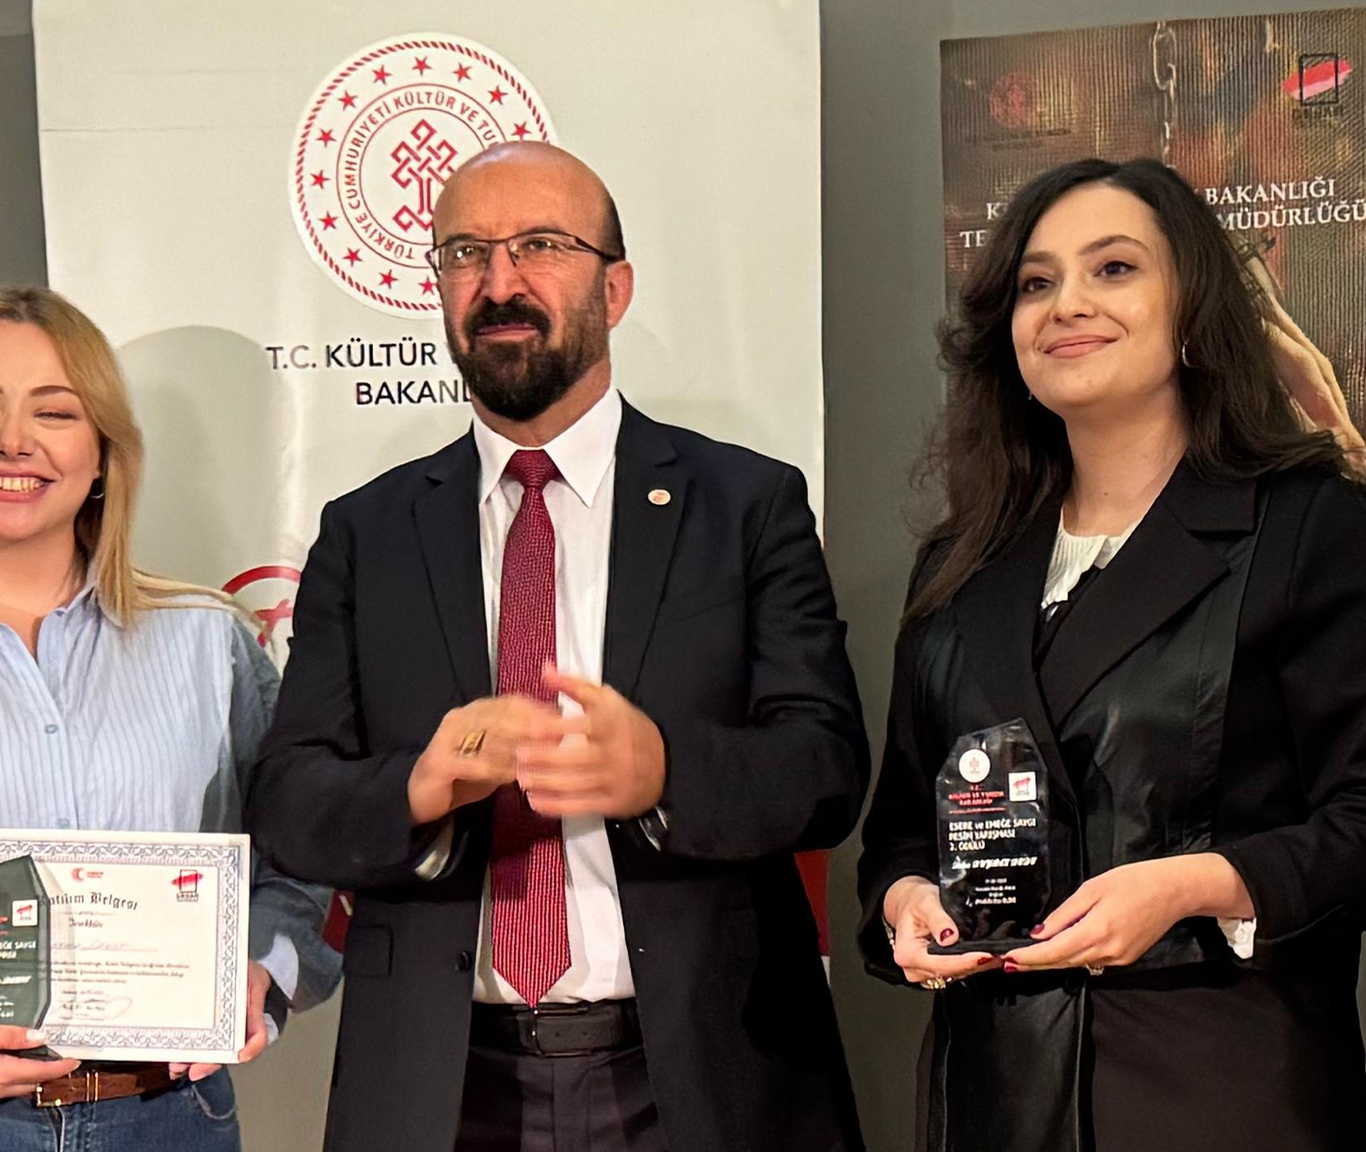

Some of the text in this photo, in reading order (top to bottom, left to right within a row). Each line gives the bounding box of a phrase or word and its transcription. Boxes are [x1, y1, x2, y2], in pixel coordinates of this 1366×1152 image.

[394, 91, 456, 110] KÜLTÜR
[460, 103, 479, 122] VE
[344, 101, 392, 209] CUMHURİYETİ
[1205, 176, 1335, 205] BAKANLIĞI
[355, 212, 415, 259] TÜRKİYE
[265, 337, 437, 370] T.C. KÜLTÜR
[355, 379, 473, 406] BAKANL
